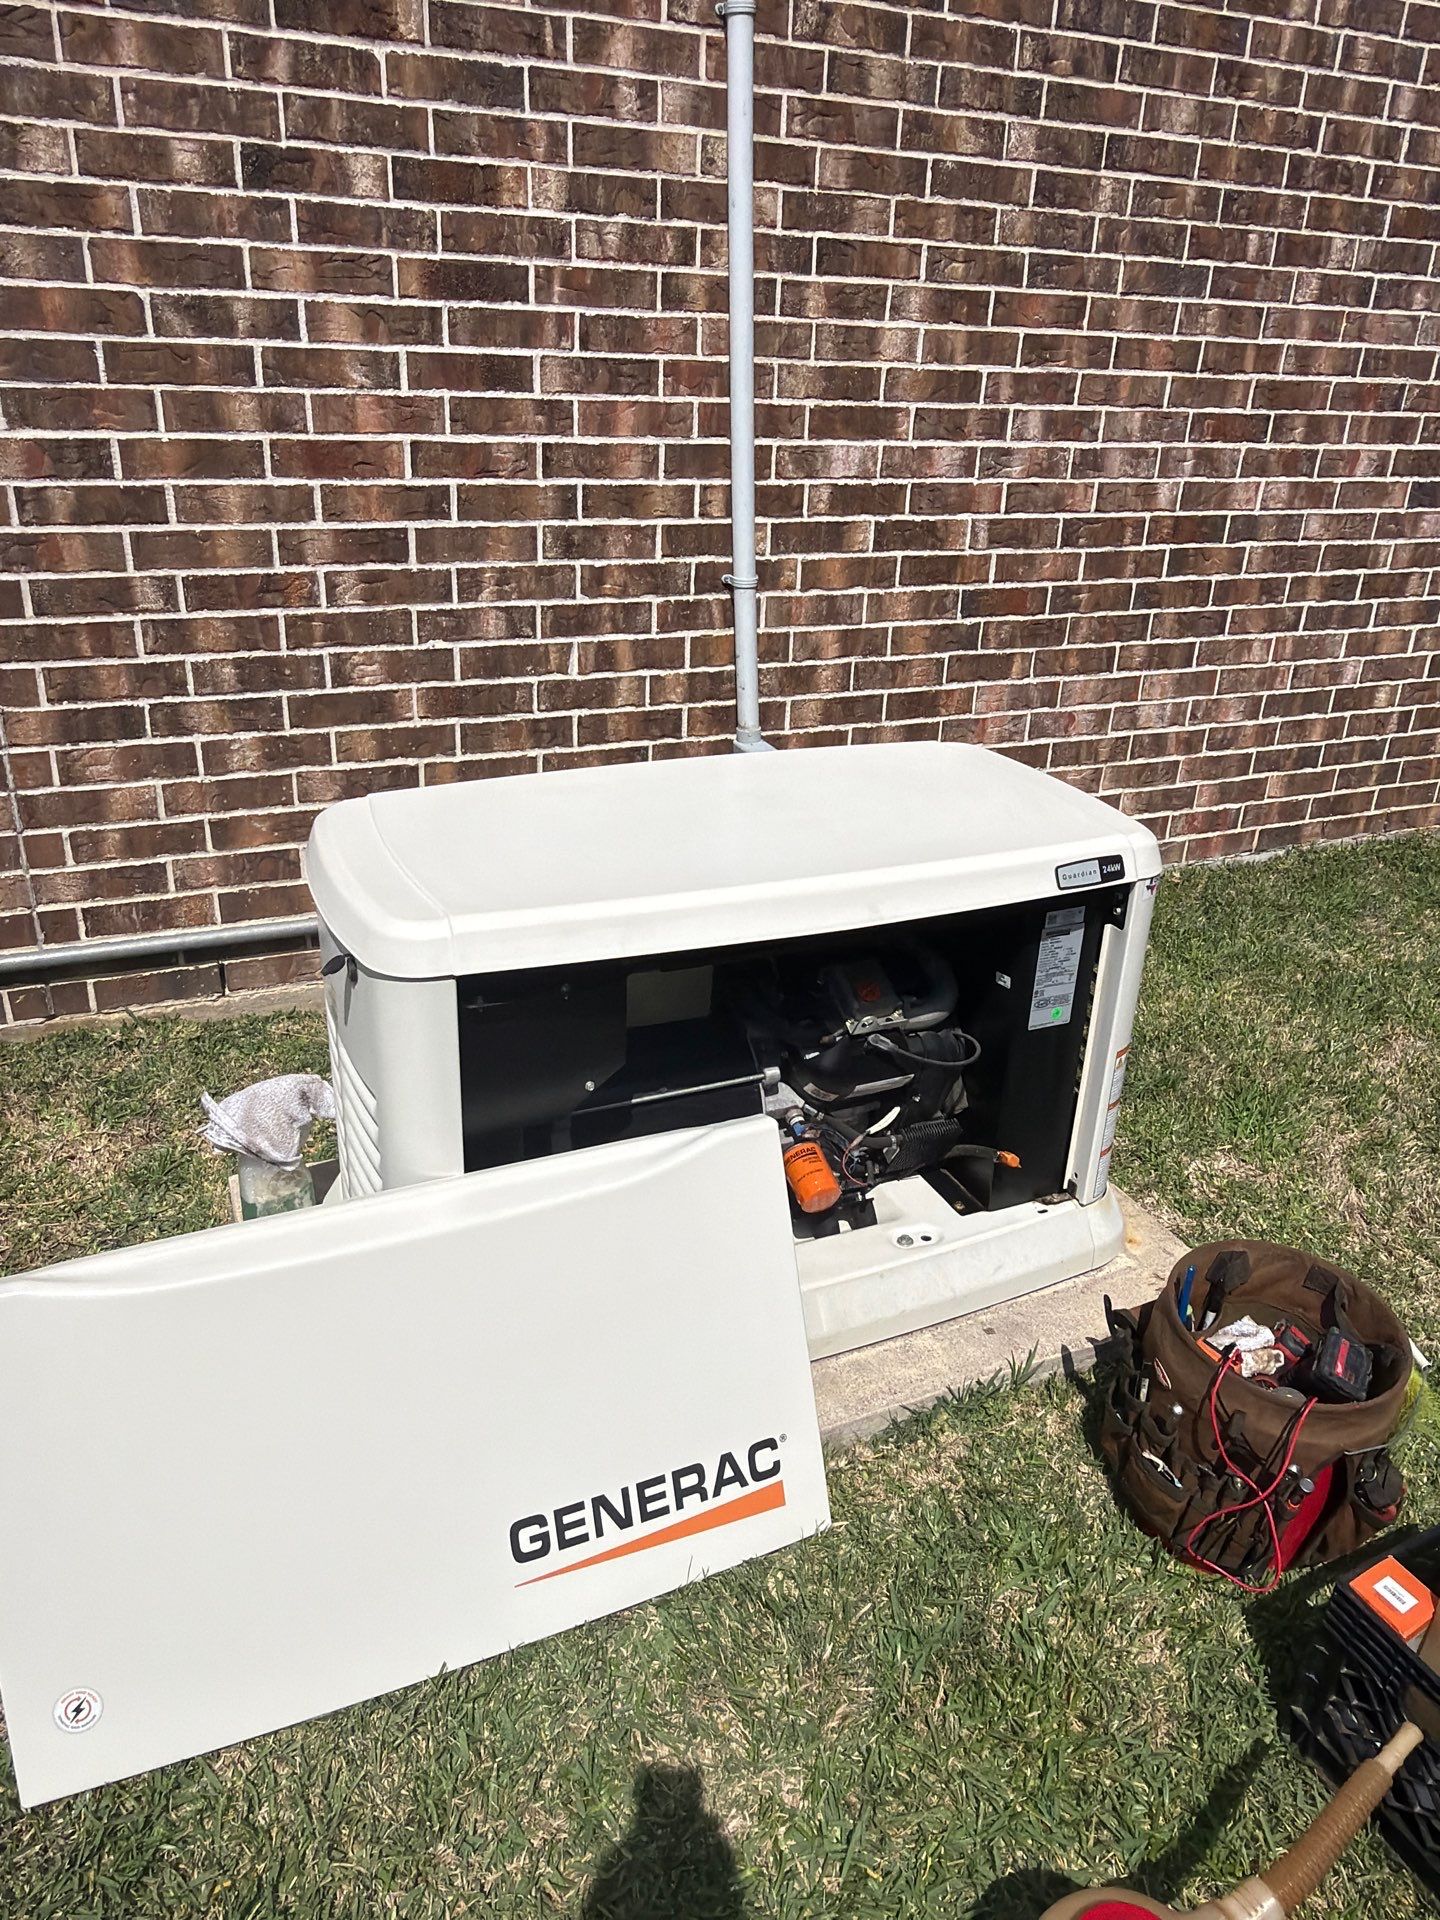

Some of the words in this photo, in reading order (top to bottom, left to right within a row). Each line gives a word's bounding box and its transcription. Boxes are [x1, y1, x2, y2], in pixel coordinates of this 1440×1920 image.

[1062, 868, 1097, 880] Guardian
[1102, 863, 1121, 874] 24kW
[509, 1437, 781, 1564] GENERAC
